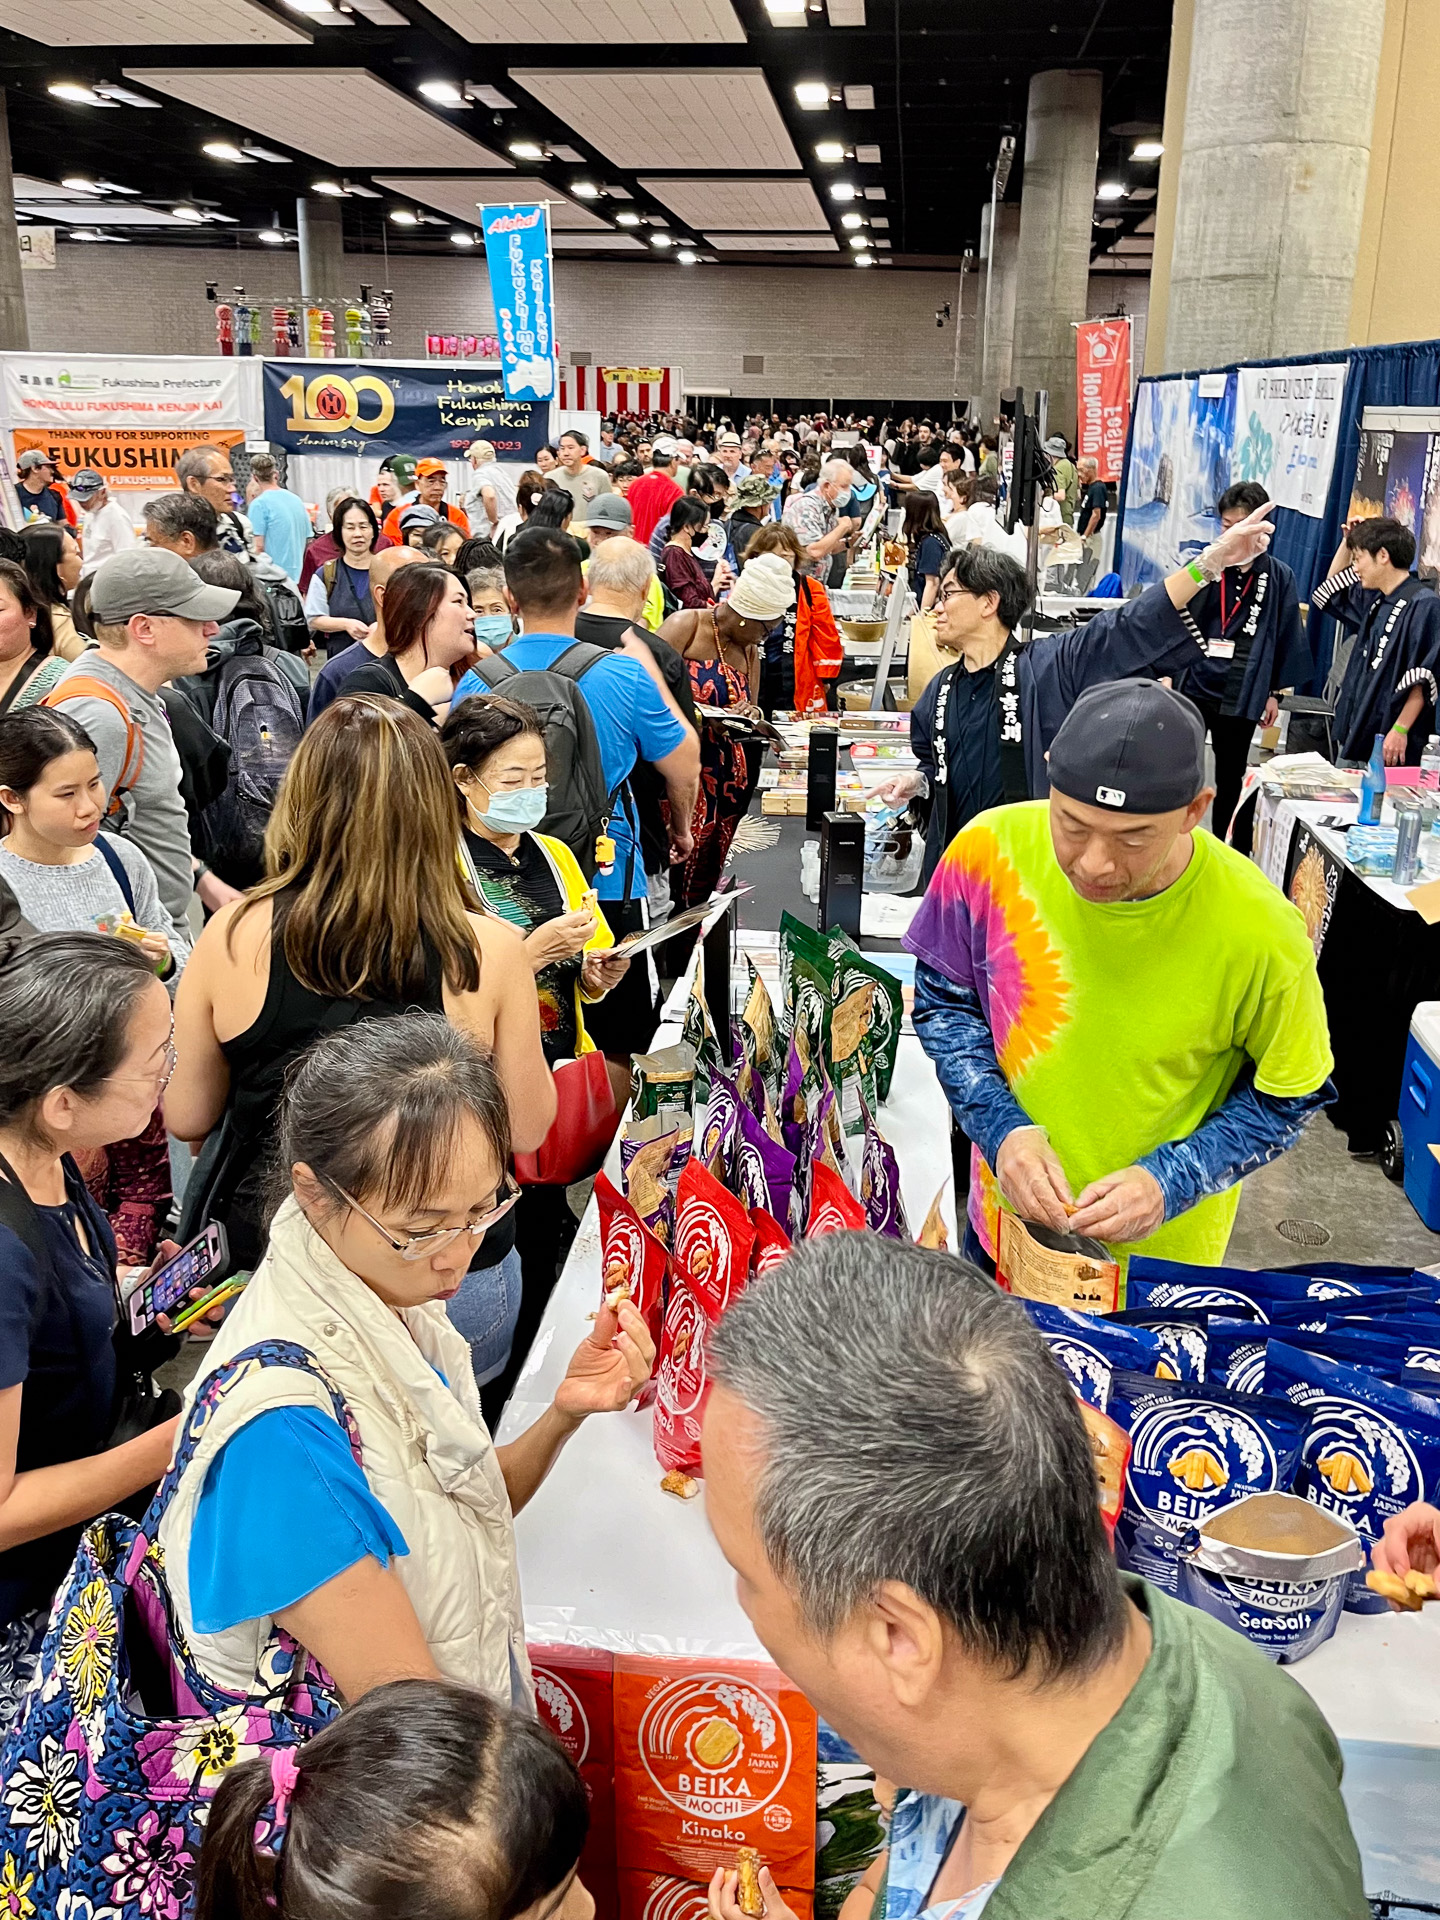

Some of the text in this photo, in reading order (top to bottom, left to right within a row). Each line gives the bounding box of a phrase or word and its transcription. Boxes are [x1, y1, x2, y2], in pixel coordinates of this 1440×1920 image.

[487, 208, 542, 235] Aloha!
[102, 378, 222, 389] Fukushima Prefecture
[21, 398, 84, 411] HONOLULU
[87, 401, 154, 412] FUKUSHIMA
[157, 402, 201, 412] KENJIN
[279, 374, 395, 434] 100
[437, 395, 532, 412] Fukushima
[440, 411, 529, 432] Kenjin Kai
[48, 431, 210, 440] THANK YOU FOR SUPPORTING
[48, 447, 190, 468] FUKUSHIM
[110, 475, 176, 485] FUKUSHIMA
[1146, 1282, 1170, 1302] VEGAN
[1228, 1344, 1252, 1361] VEGAN
[1229, 1350, 1252, 1371] GLUTEN
[1286, 1382, 1309, 1397] VEGAN
[1307, 1388, 1326, 1400] FREE
[1129, 1395, 1174, 1420] GLUTEN FREE
[1130, 1393, 1156, 1407] VEGAN
[1157, 1490, 1215, 1519] BEIK
[1305, 1483, 1375, 1535] BEIKA
[1251, 1592, 1306, 1608] MOCHI
[1238, 1612, 1275, 1630] Sea
[644, 1675, 672, 1701] VEGAN
[748, 1758, 779, 1769] JAPAN
[678, 1773, 752, 1798] BEIKA
[688, 1798, 739, 1815] MOCHI
[681, 1819, 746, 1842] Kinako
